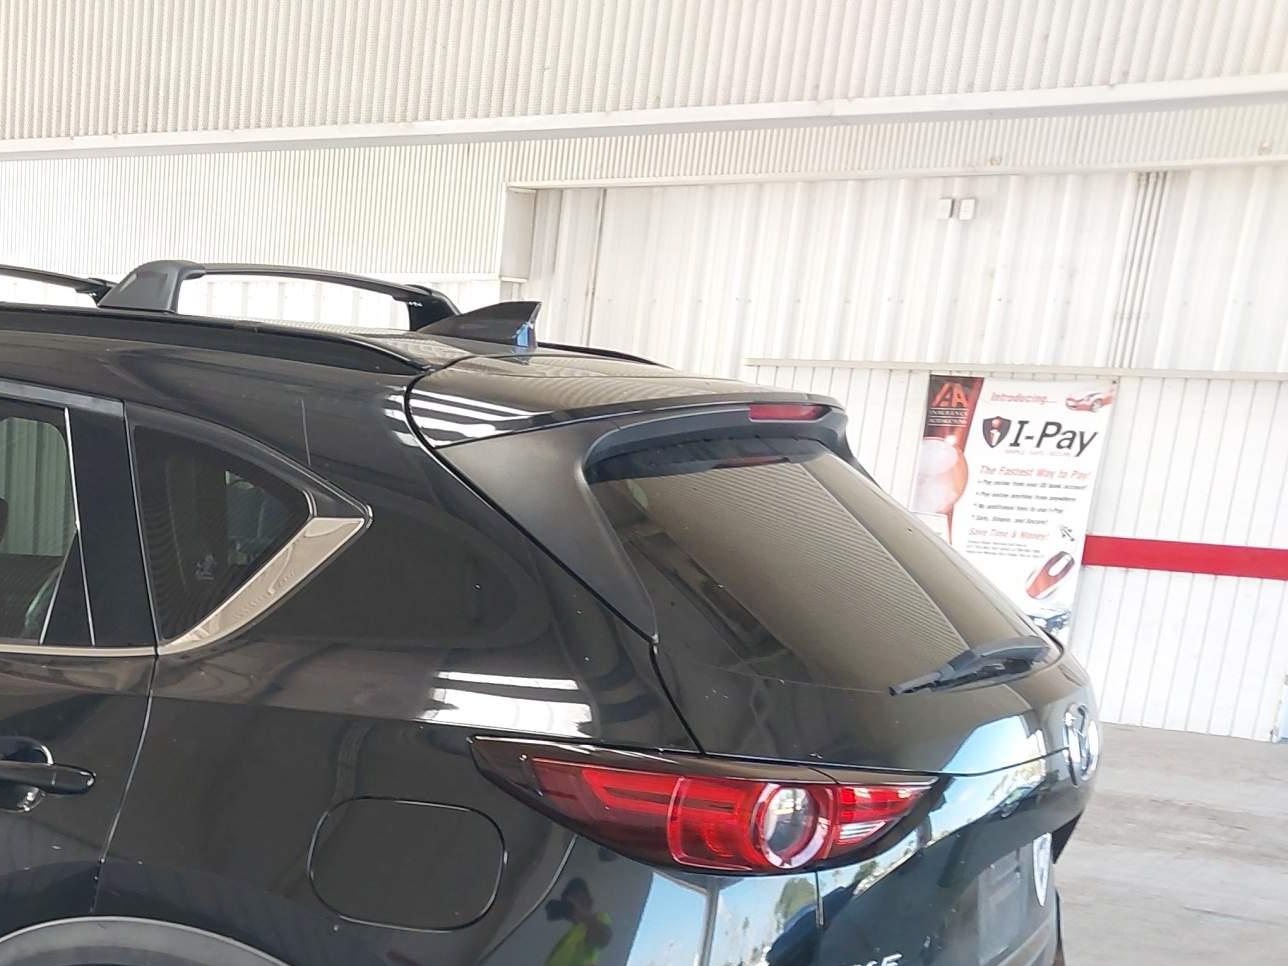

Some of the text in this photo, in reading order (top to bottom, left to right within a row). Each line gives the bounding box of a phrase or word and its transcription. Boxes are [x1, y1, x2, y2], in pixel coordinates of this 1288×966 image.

[1009, 420, 1099, 457] I-Pay
[979, 464, 996, 475] The
[998, 466, 1034, 478] Fastest
[1036, 468, 1056, 480] Way
[1058, 469, 1068, 479] to
